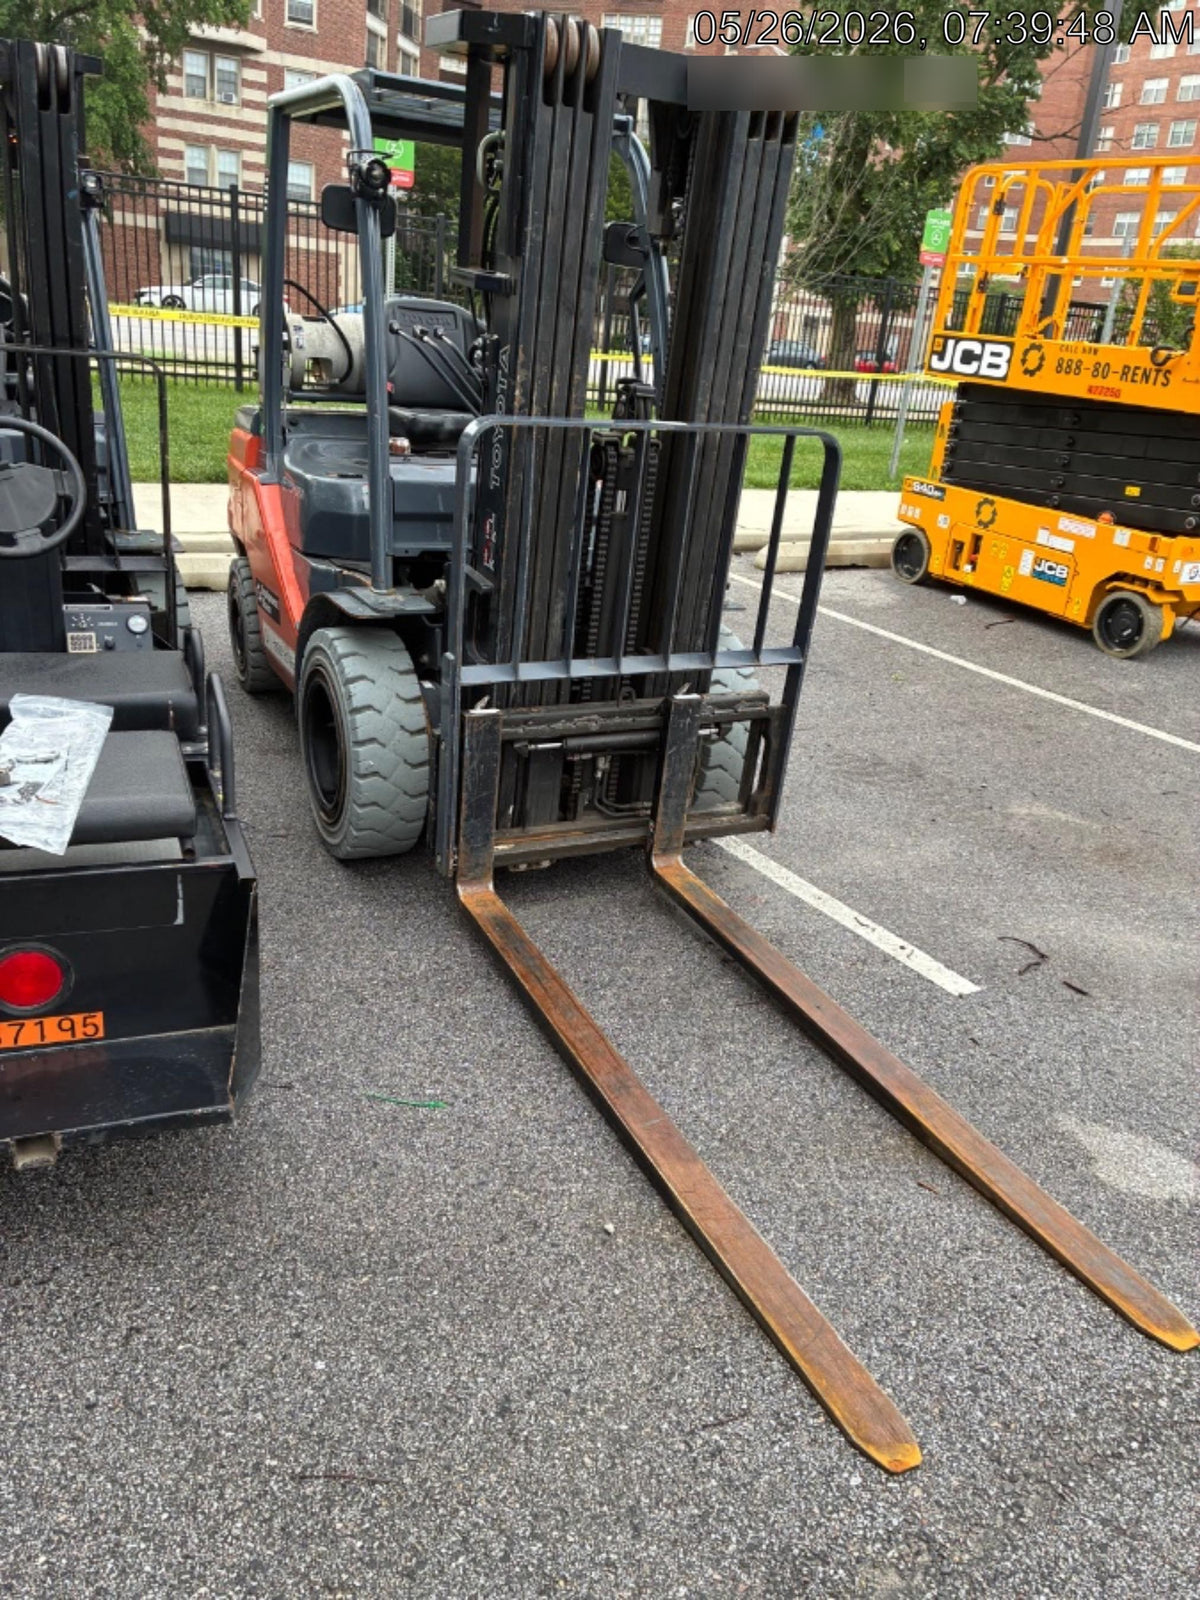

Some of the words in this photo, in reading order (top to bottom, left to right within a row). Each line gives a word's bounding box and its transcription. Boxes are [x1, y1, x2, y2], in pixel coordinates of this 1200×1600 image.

[930, 339, 1012, 378] JCB
[1055, 357, 1172, 387] 888-80-RENTS
[1034, 559, 1069, 578] JCB
[0, 1014, 99, 1044] 7195
